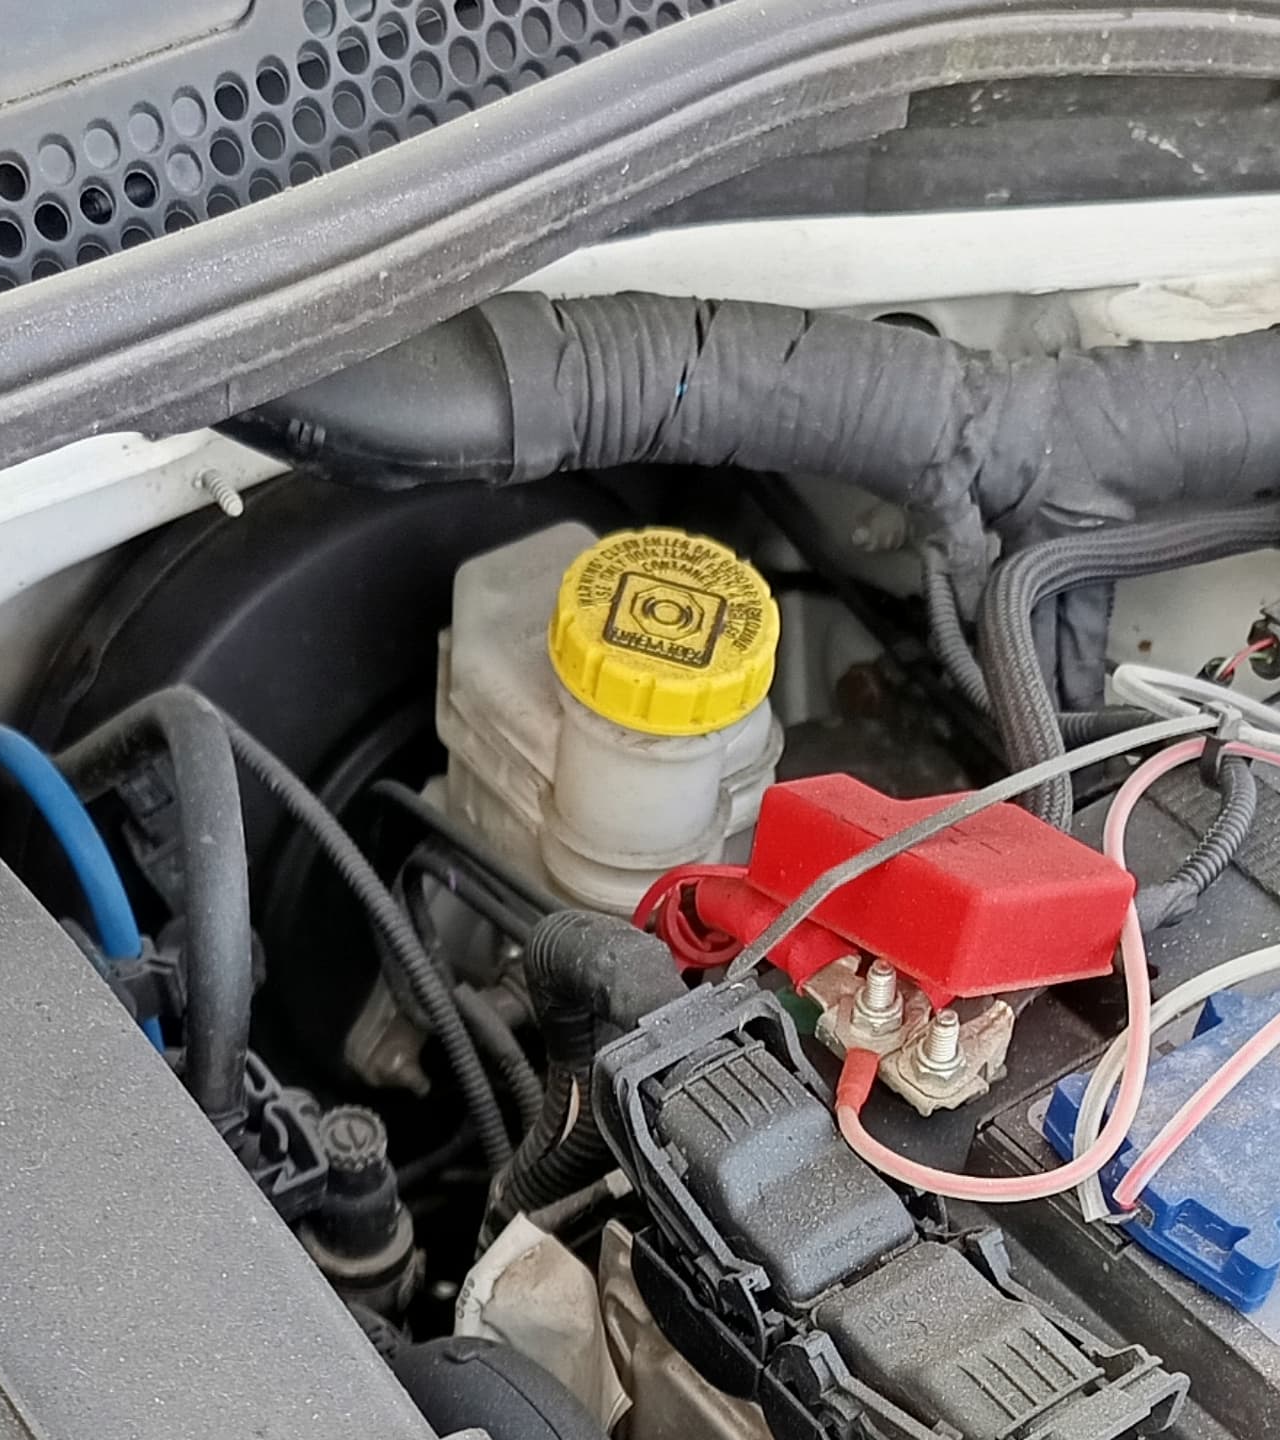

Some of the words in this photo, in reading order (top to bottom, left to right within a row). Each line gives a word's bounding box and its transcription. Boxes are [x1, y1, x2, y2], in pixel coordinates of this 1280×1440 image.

[600, 538, 640, 561] CLEAN
[642, 535, 691, 552] FILLER
[599, 560, 628, 585] ONLY
